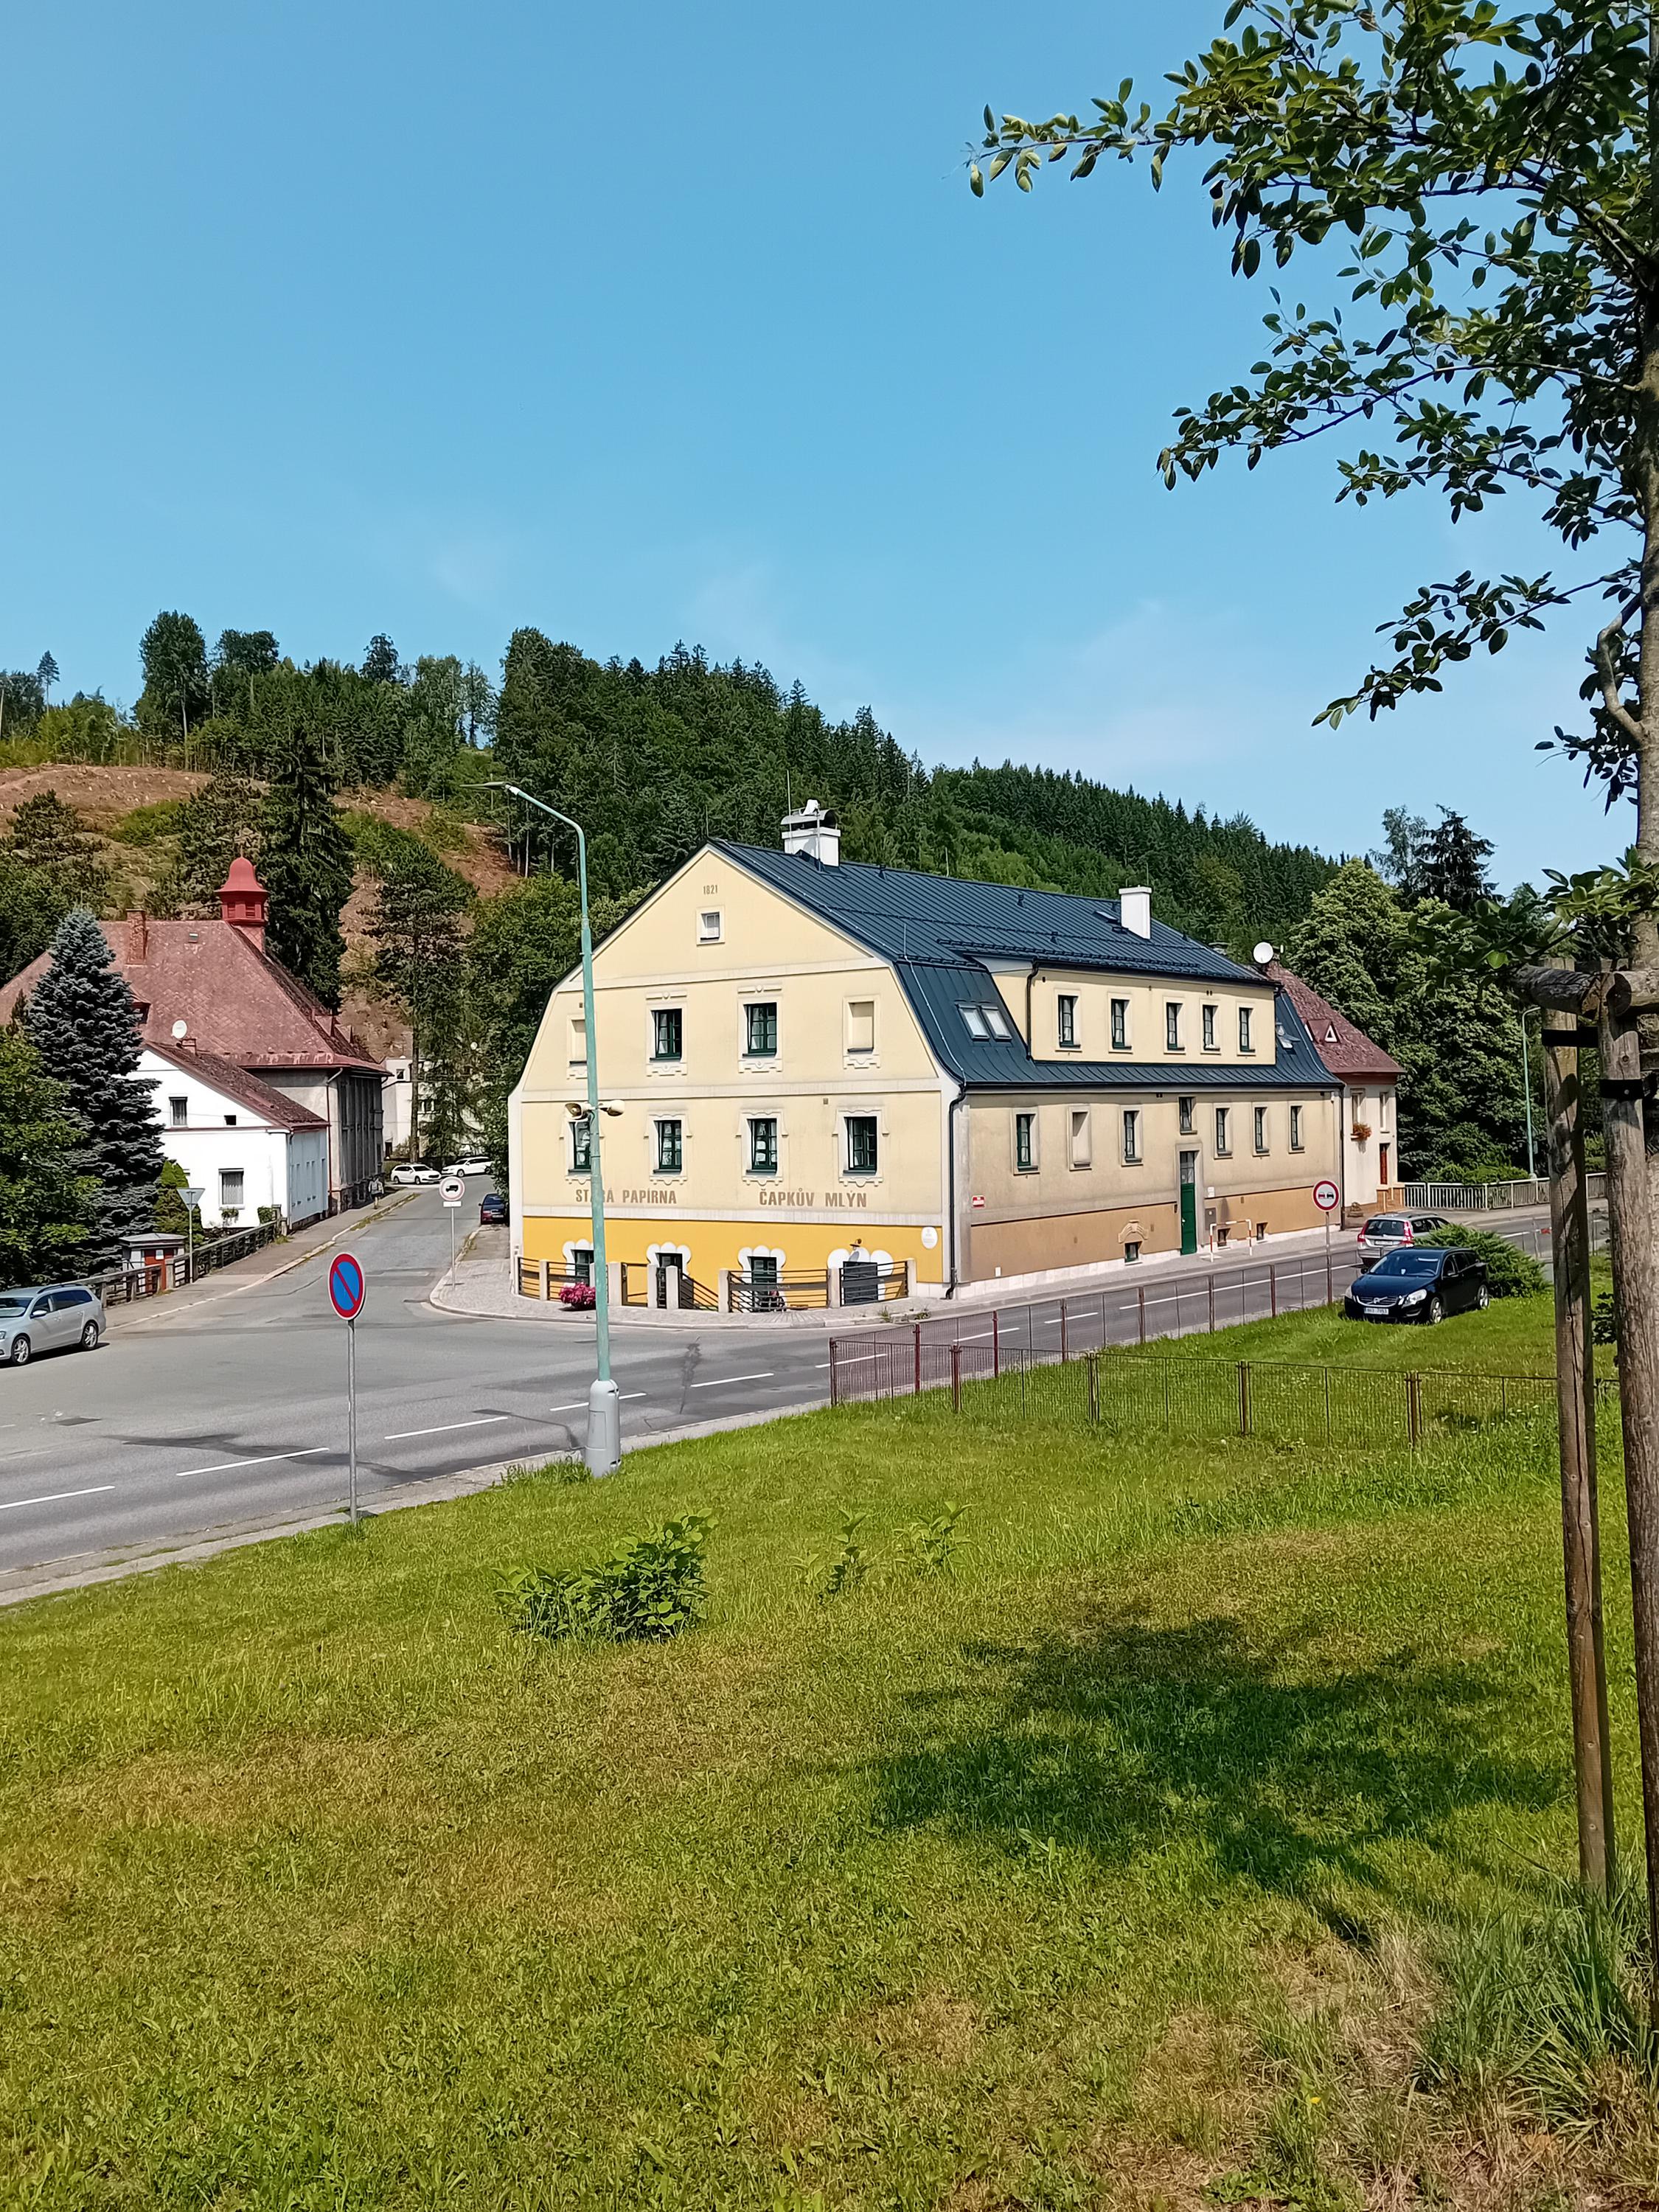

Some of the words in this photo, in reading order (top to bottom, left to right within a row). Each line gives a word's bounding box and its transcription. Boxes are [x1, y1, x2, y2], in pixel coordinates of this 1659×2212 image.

[703, 884, 718, 895] 1821
[575, 1187, 615, 1203] STÁ
[622, 1188, 677, 1204] PAPÍRNA
[759, 1187, 815, 1207] ČAPKŮV
[825, 1190, 867, 1208] MLÝN
